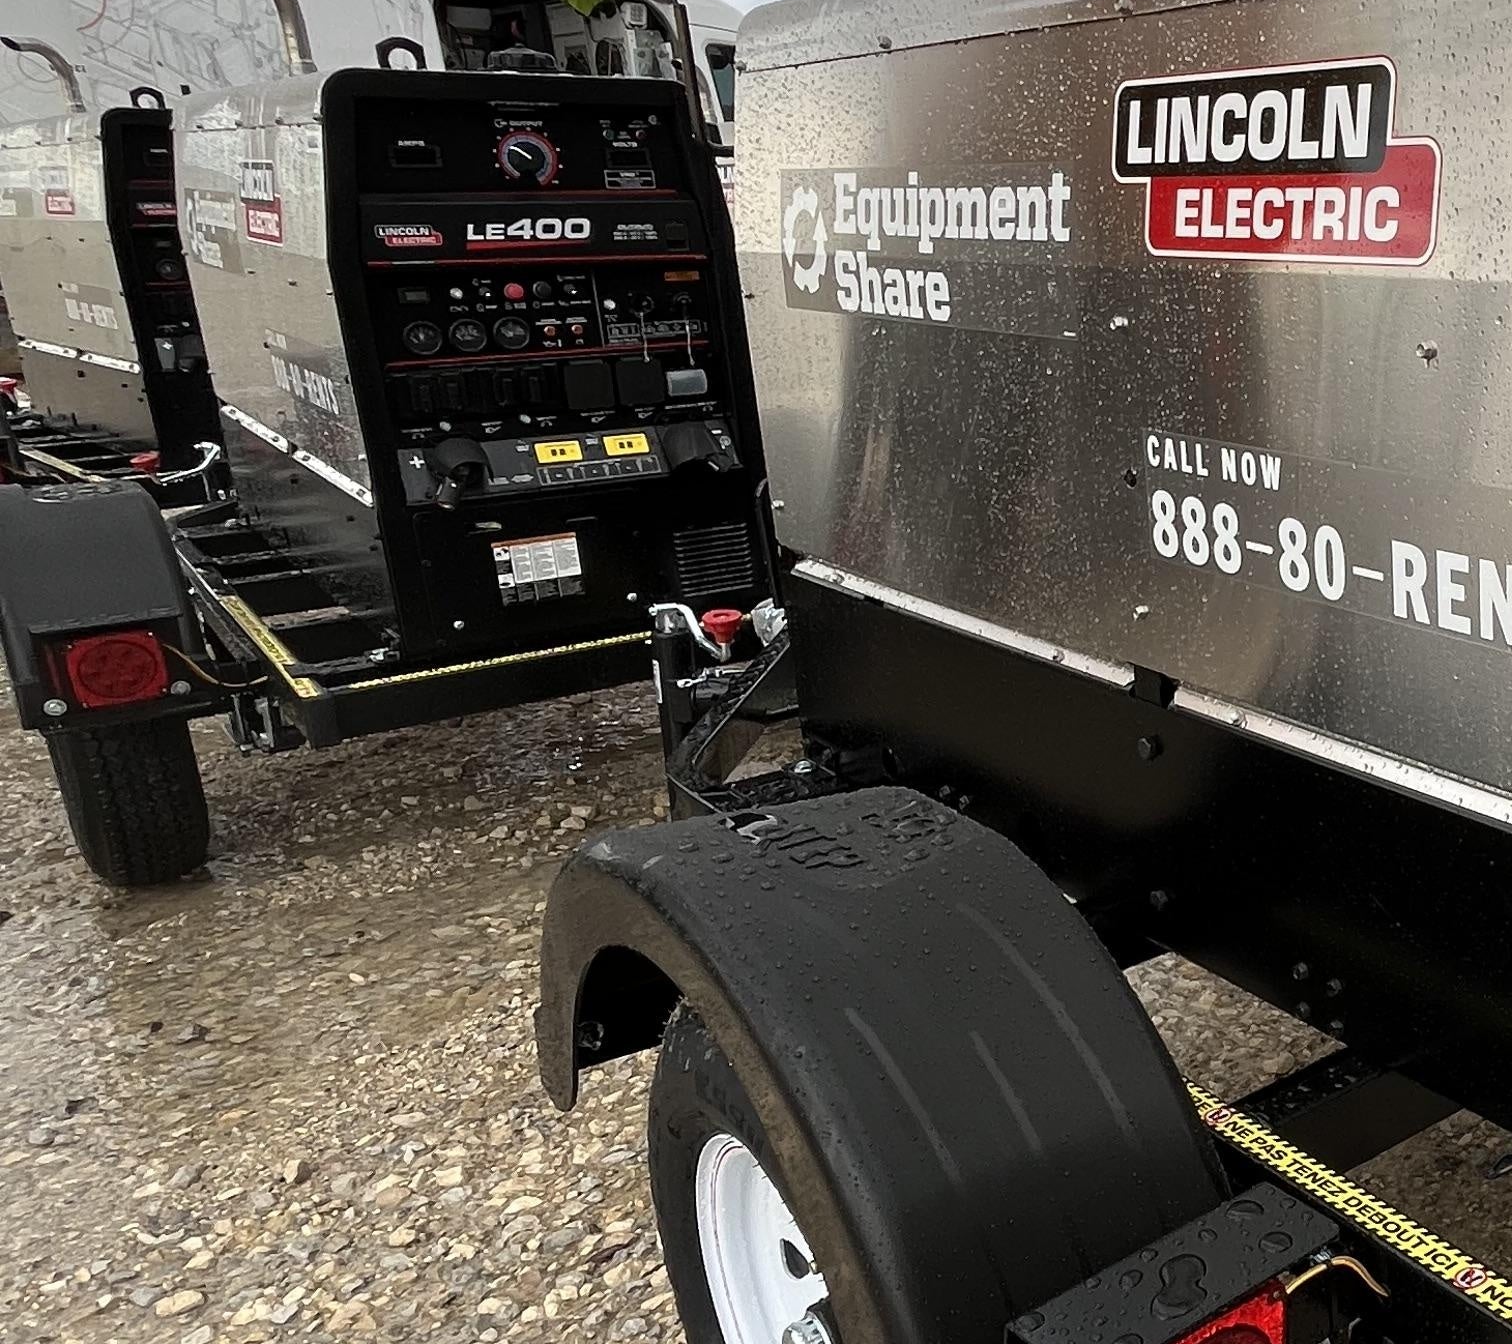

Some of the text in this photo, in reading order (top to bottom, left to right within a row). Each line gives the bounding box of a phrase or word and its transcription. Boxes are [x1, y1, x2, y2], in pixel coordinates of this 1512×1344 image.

[1126, 83, 1375, 166] LINCOLN
[377, 227, 431, 237] LINCOLN
[467, 218, 591, 242] LE400
[833, 171, 1071, 251] Equipment
[1174, 186, 1401, 242] ELECTRIC
[834, 250, 951, 322] Share
[1146, 435, 1282, 492] CALL NOW
[1226, 1120, 1458, 1272] NE PAS TENEZ DEBOUT ICI
